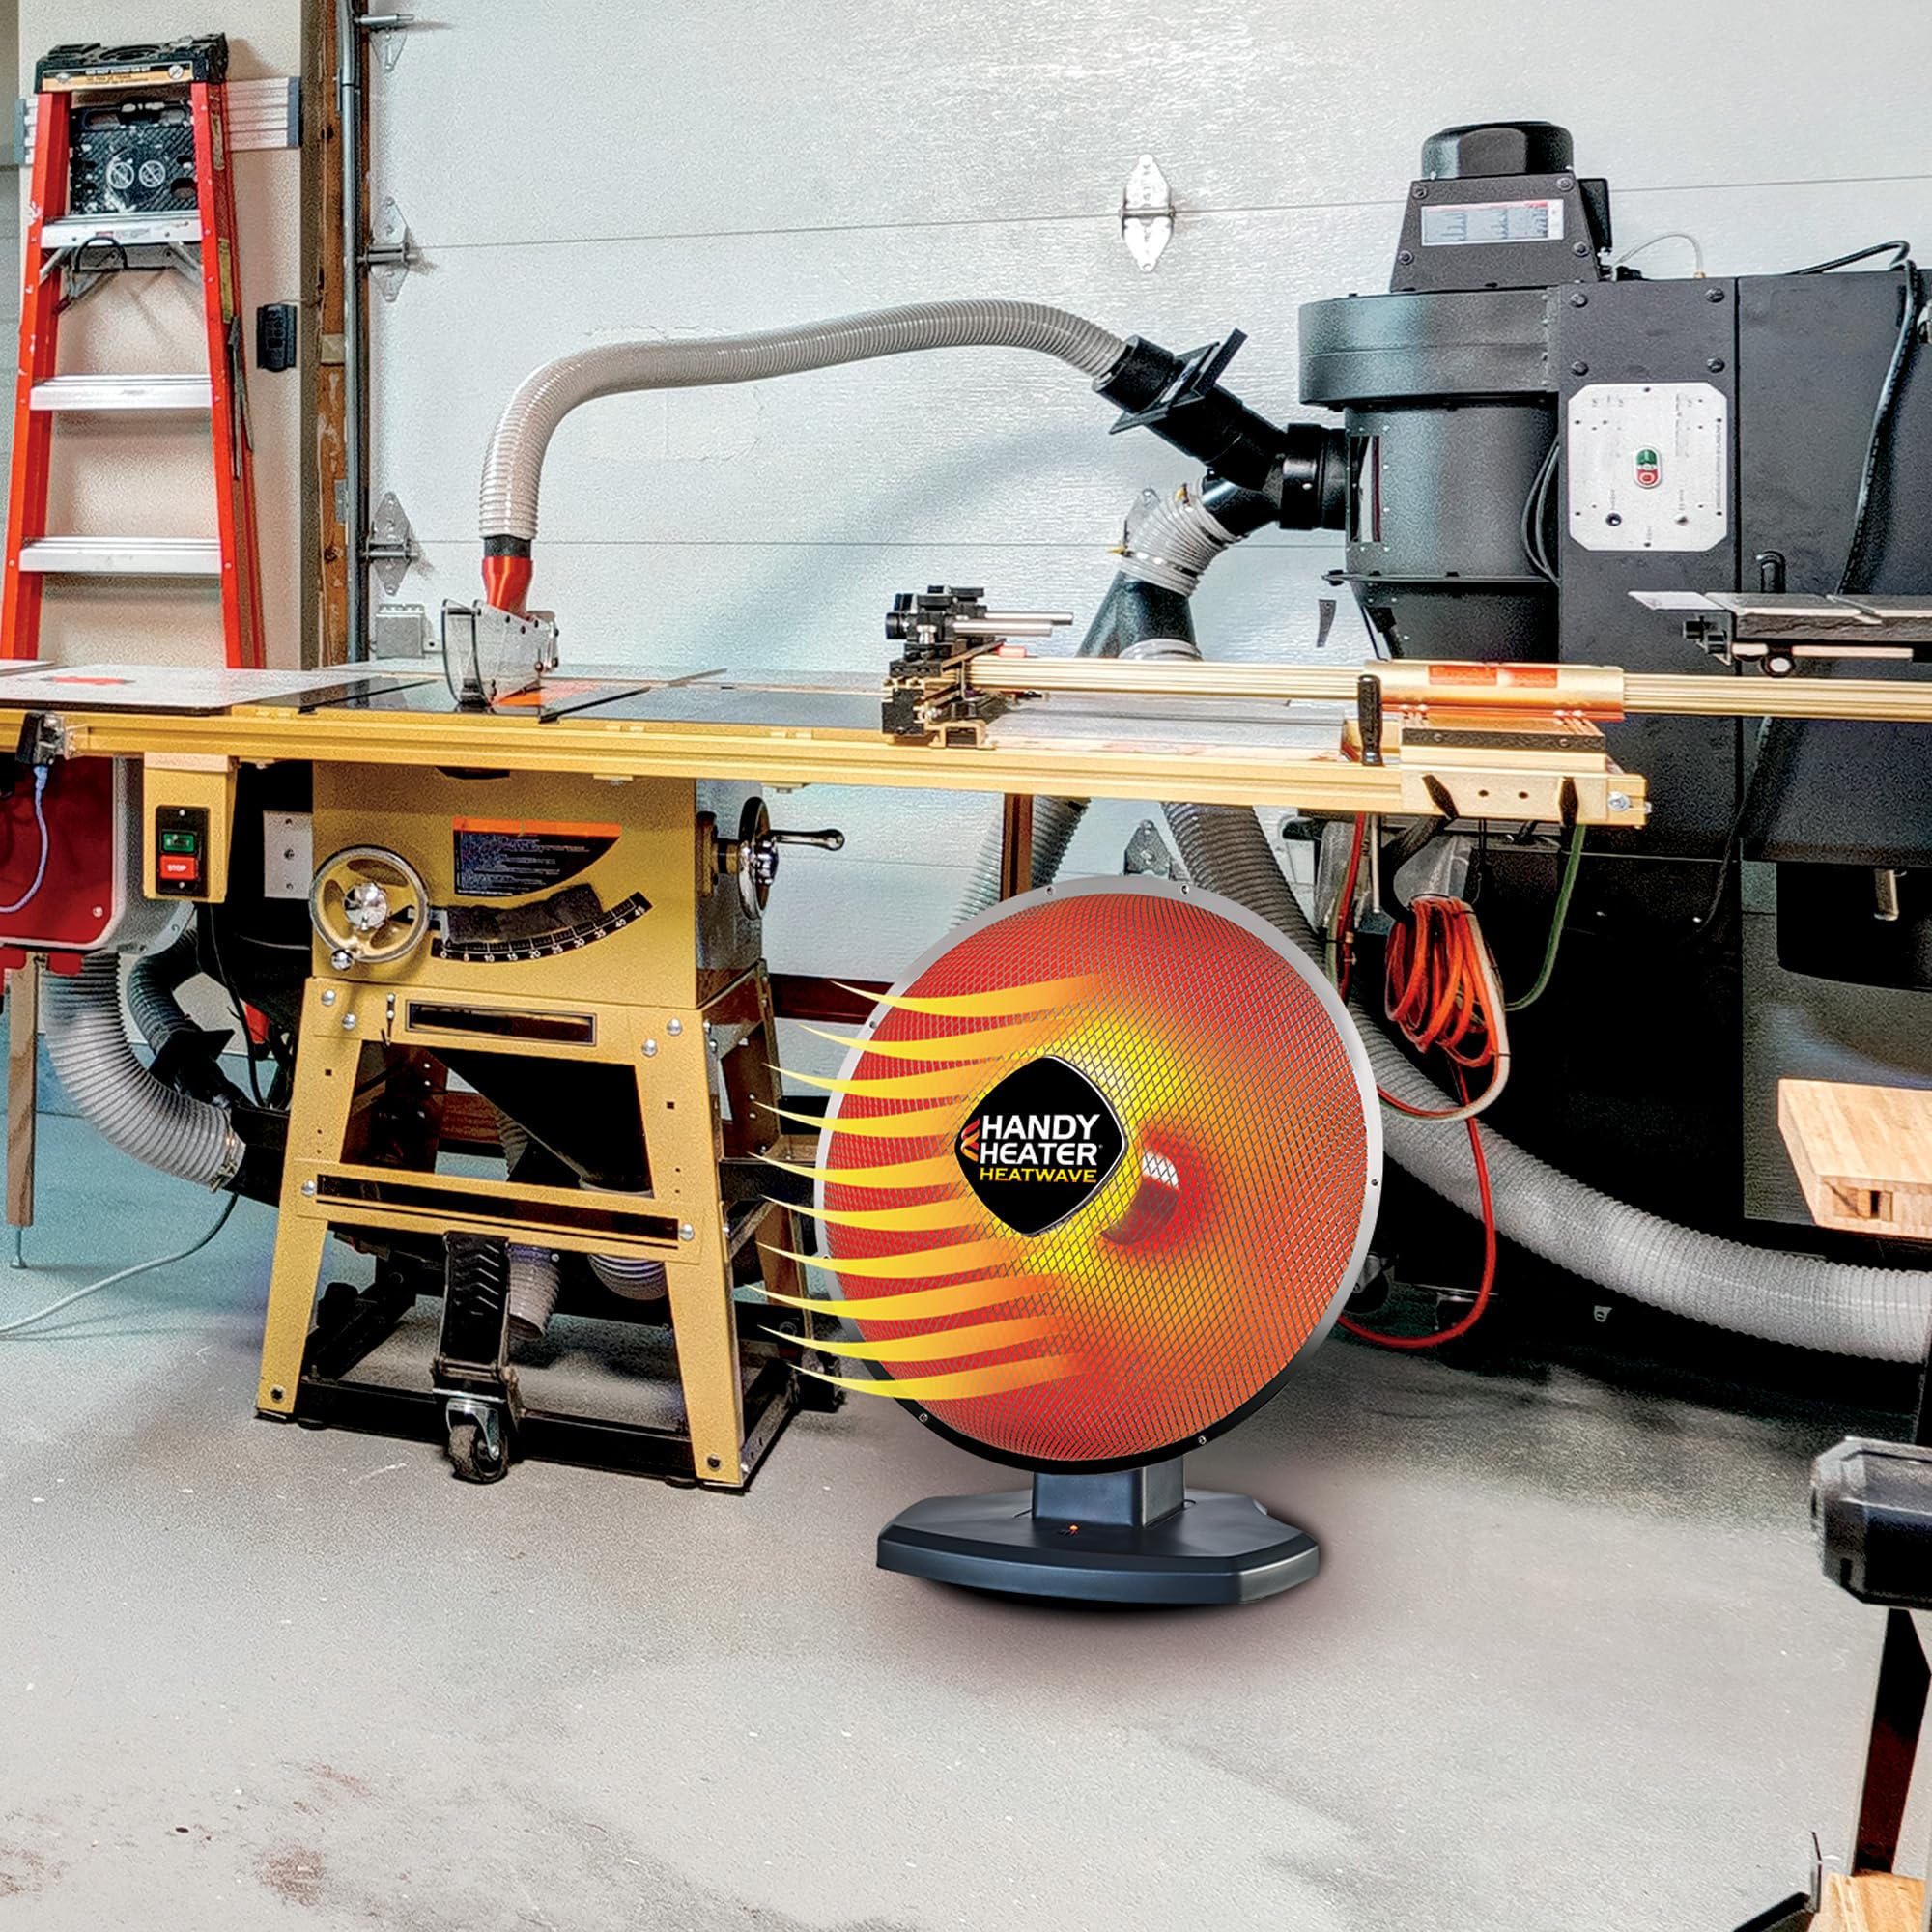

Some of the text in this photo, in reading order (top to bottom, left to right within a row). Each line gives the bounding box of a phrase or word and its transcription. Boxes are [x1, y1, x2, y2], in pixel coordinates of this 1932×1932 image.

[167, 864, 186, 872] STOP
[484, 953, 495, 962] 10
[507, 952, 518, 962] 15
[528, 949, 541, 959] 20
[573, 938, 585, 949] 30
[594, 928, 607, 939] 35
[615, 918, 627, 927] 40
[981, 1114, 1100, 1140] HANDY
[980, 1142, 1098, 1166] HEATER
[980, 1167, 1097, 1183] HEATWAVE
